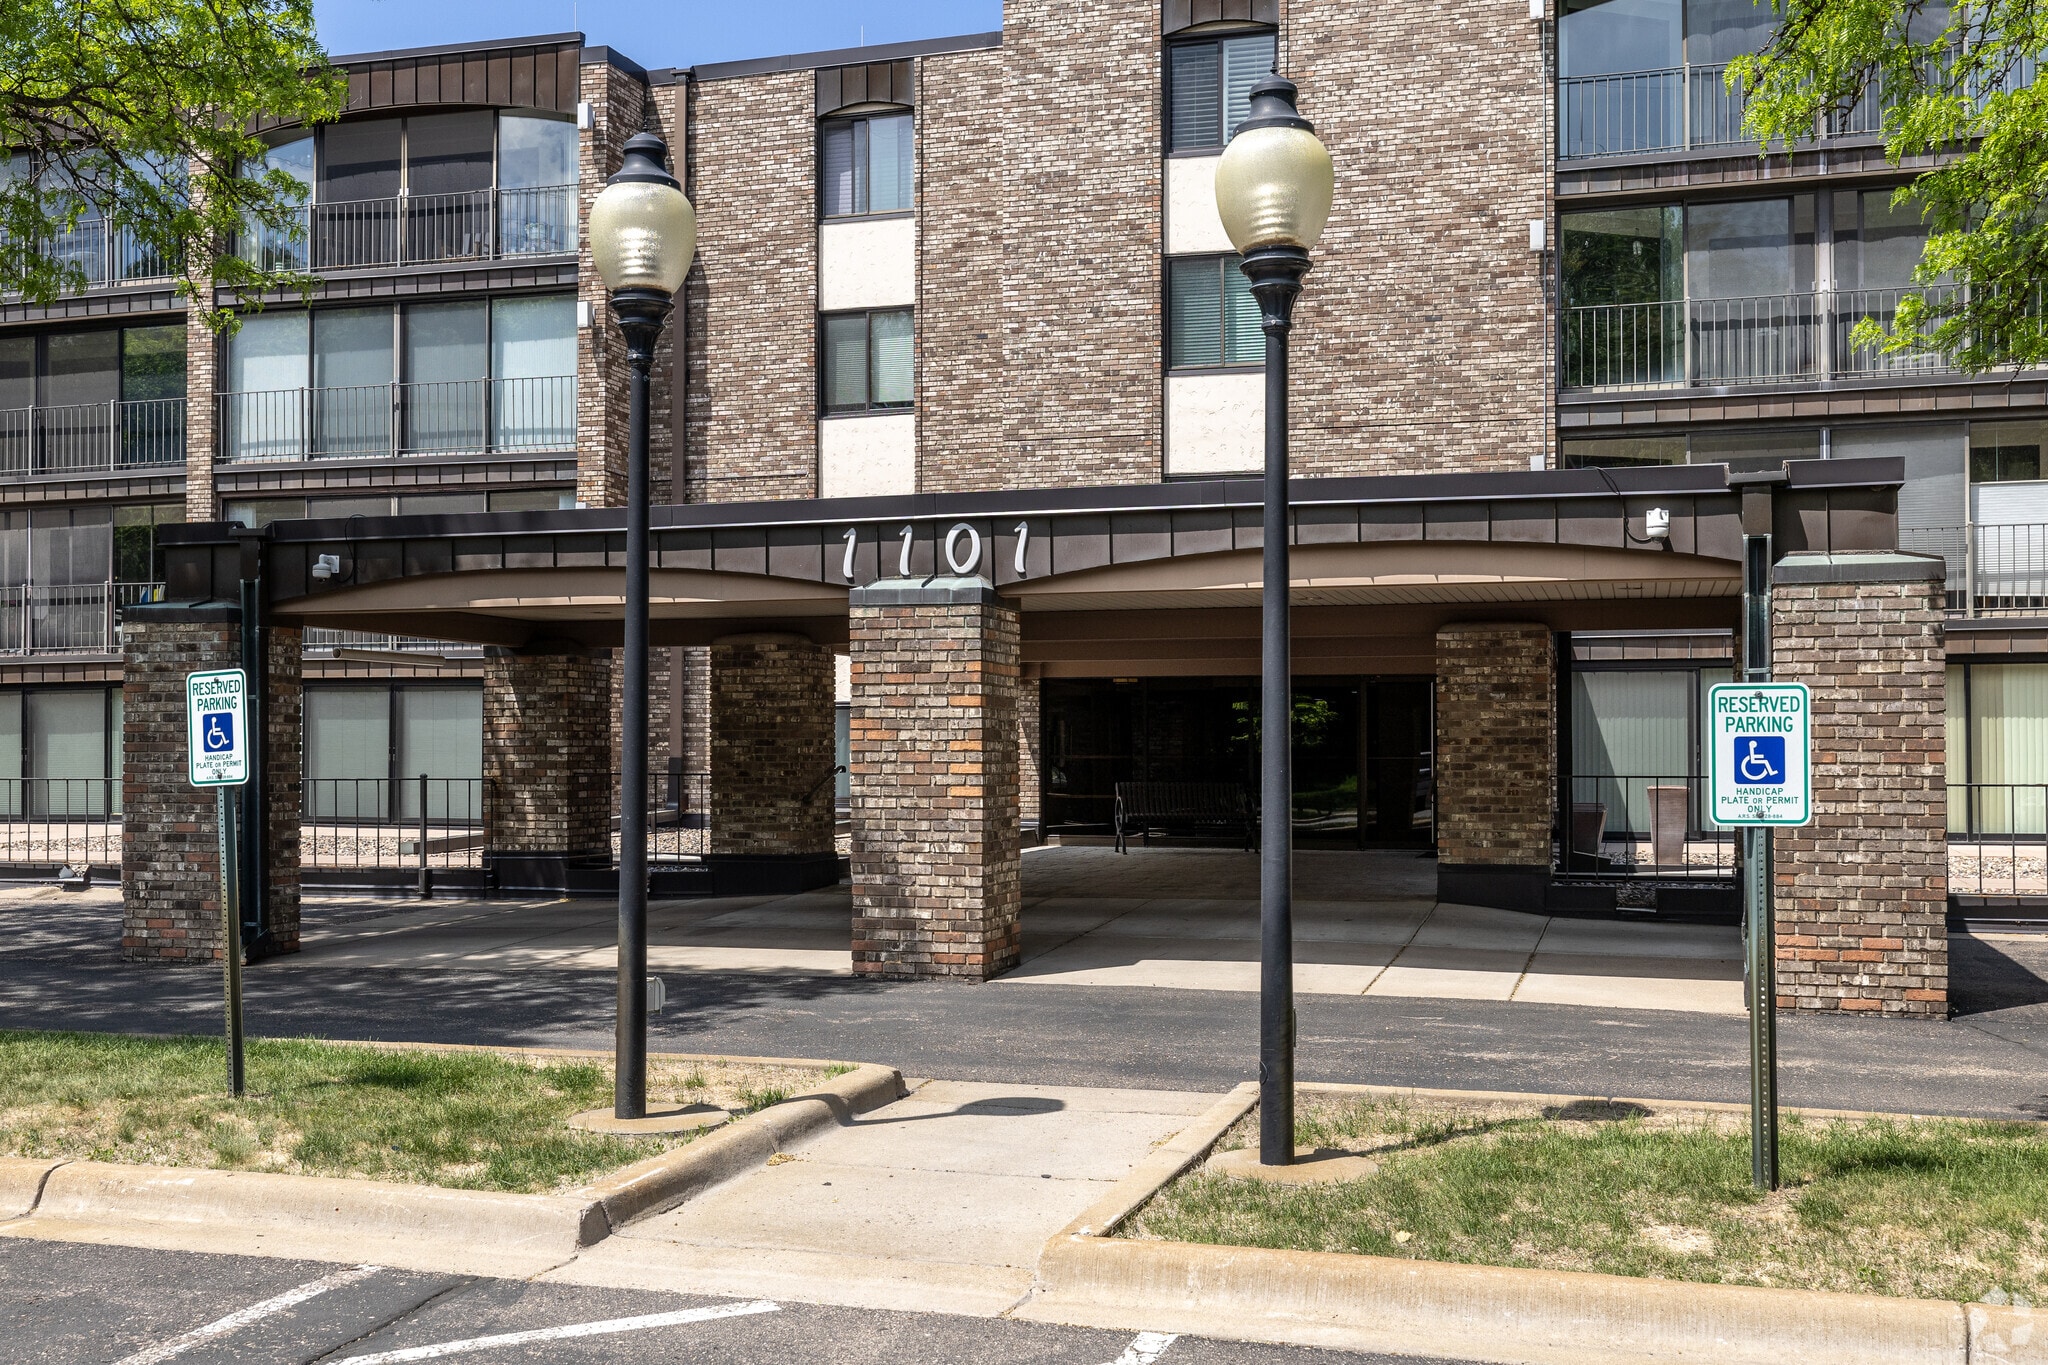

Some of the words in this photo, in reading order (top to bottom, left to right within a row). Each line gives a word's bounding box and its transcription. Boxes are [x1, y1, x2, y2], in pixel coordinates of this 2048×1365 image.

[843, 521, 1028, 578] 1101
[192, 679, 241, 696] RESERVED
[197, 696, 237, 711] PARKING
[1718, 696, 1800, 713] RESERVED
[1725, 716, 1793, 732] PARKING
[204, 753, 233, 761] HANDICAP
[1736, 787, 1784, 795] HANDICAP
[1721, 796, 1749, 804] PLATE
[1766, 796, 1799, 804] PERMIT
[1747, 805, 1772, 813] ONLY
